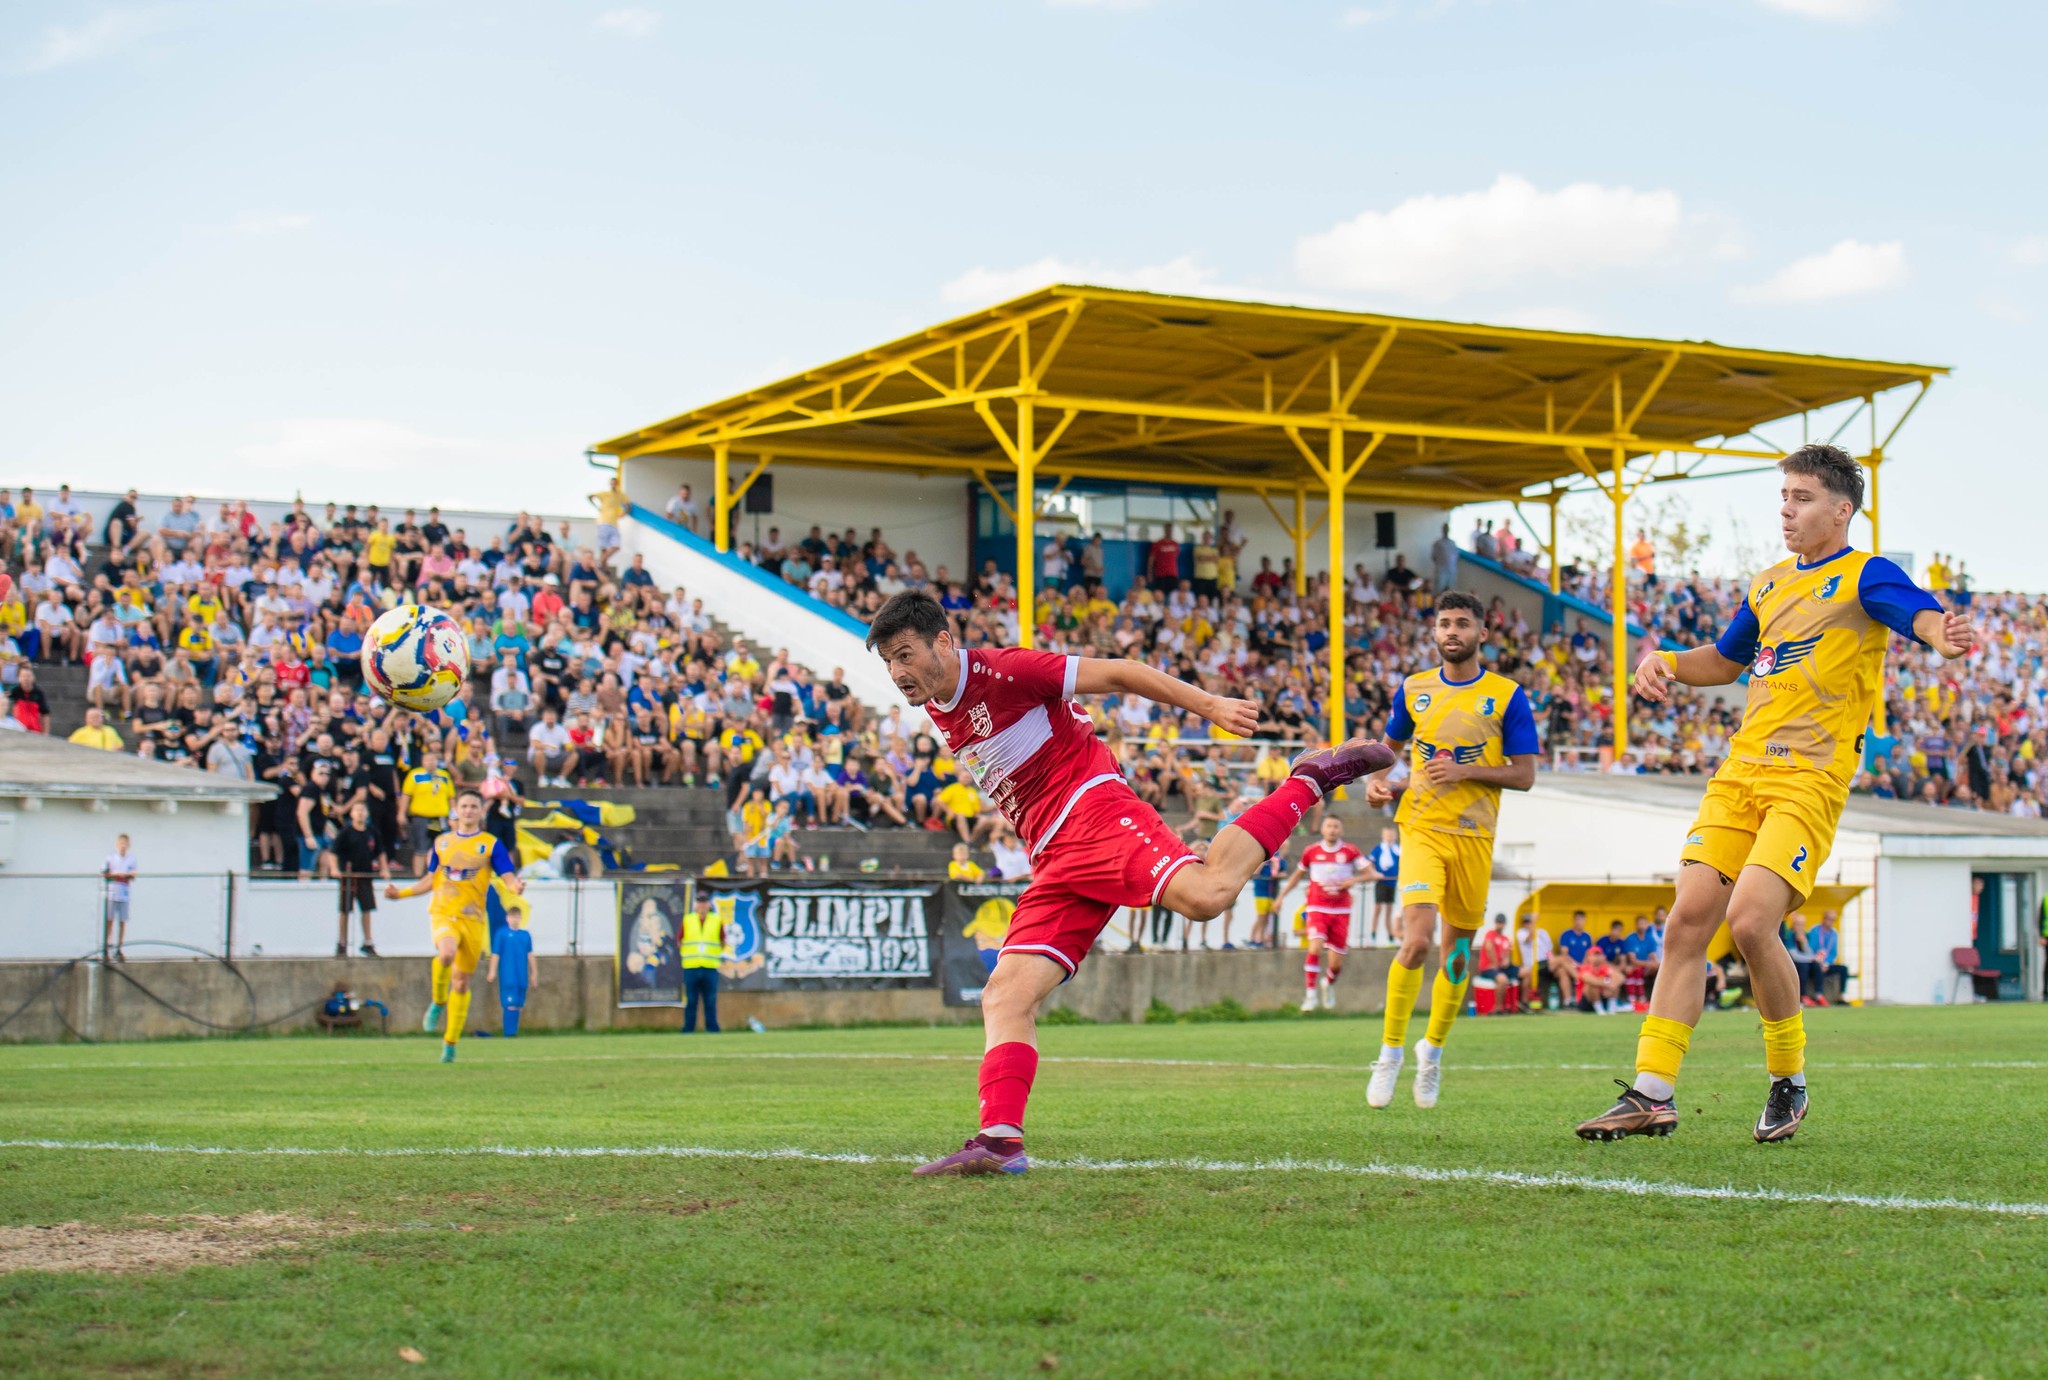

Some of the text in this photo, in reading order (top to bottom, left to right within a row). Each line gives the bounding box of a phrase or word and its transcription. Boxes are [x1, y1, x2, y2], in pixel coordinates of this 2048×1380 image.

[1765, 745, 1789, 757] 1921
[1150, 855, 1171, 878] JAKO
[1791, 846, 1807, 872] 2
[765, 896, 928, 938] OLIMPIA
[869, 938, 929, 971] 1921
